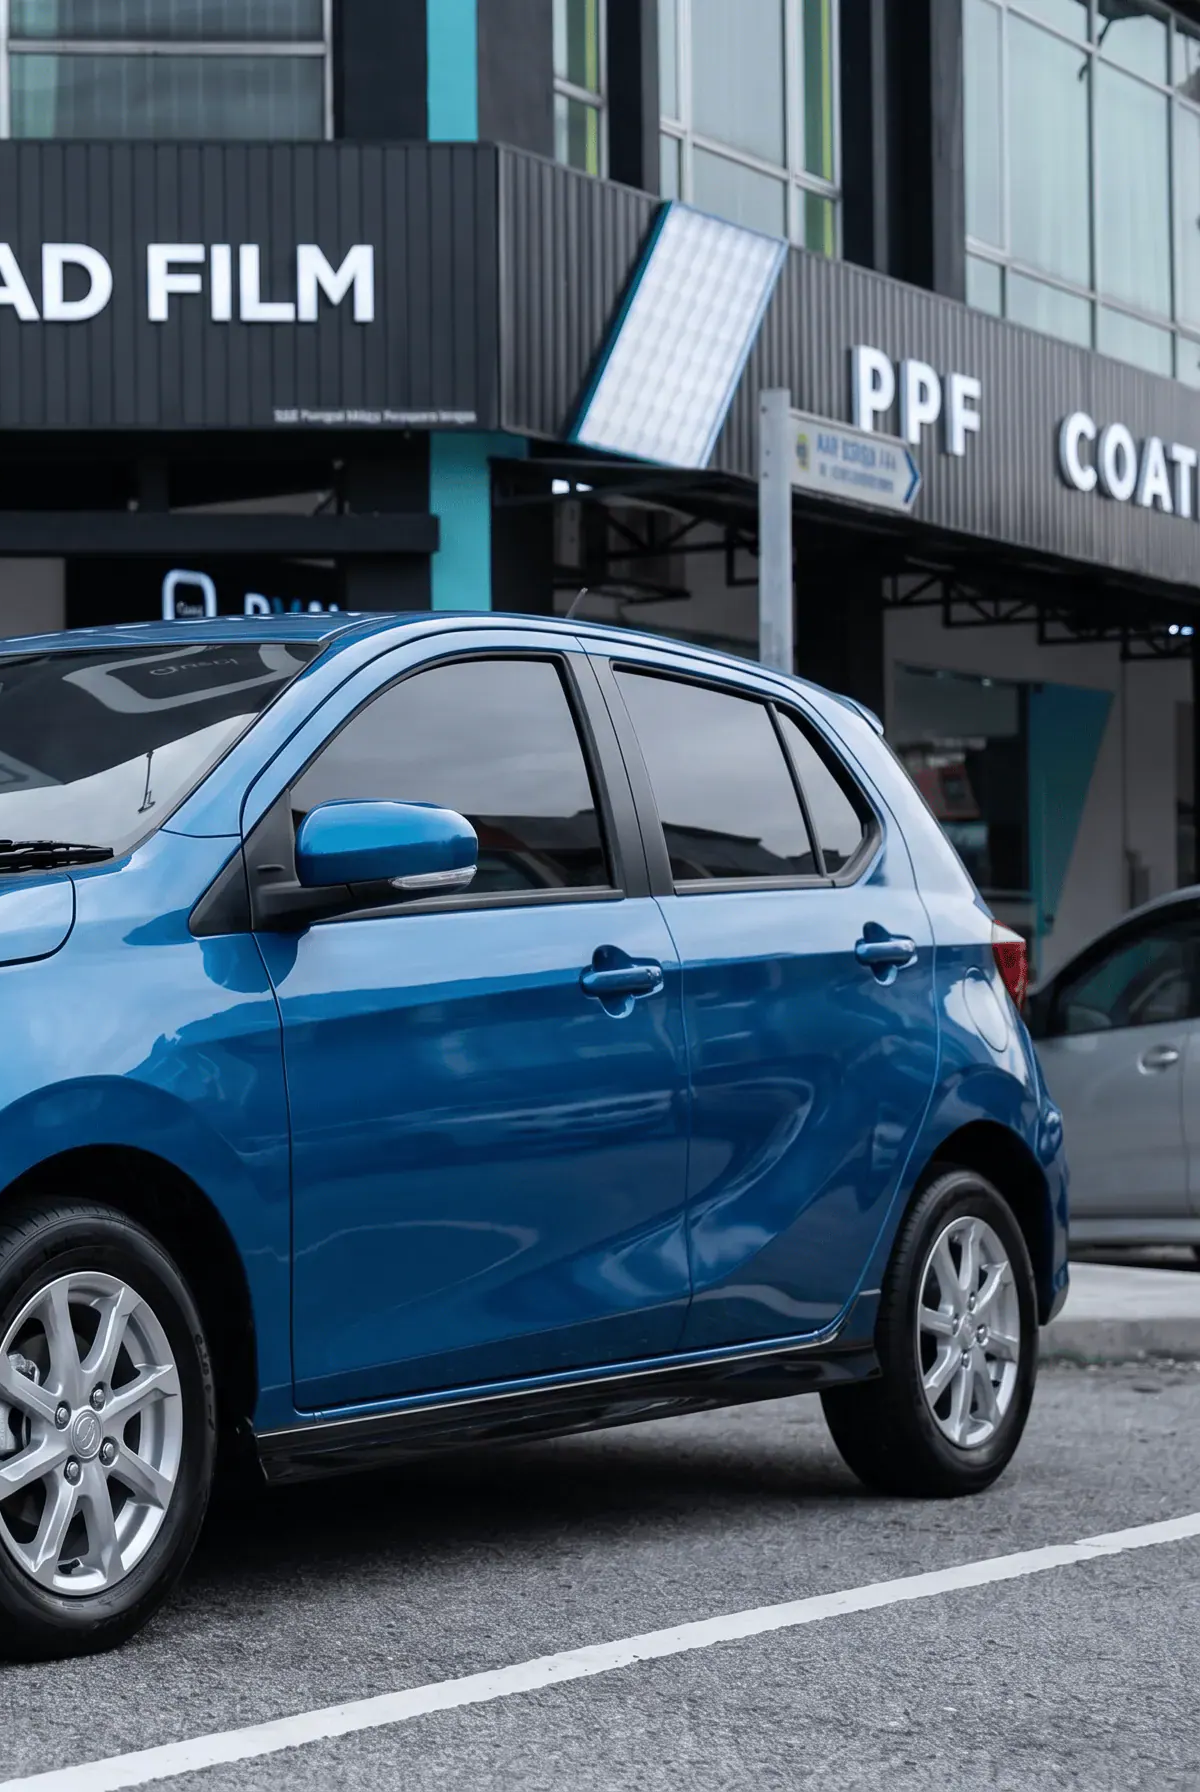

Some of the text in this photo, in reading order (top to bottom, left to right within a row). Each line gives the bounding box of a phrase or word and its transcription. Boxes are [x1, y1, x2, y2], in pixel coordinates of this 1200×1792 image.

[147, 244, 375, 322] FILM
[851, 344, 982, 457] PPF
[1059, 411, 1199, 519] COAT
